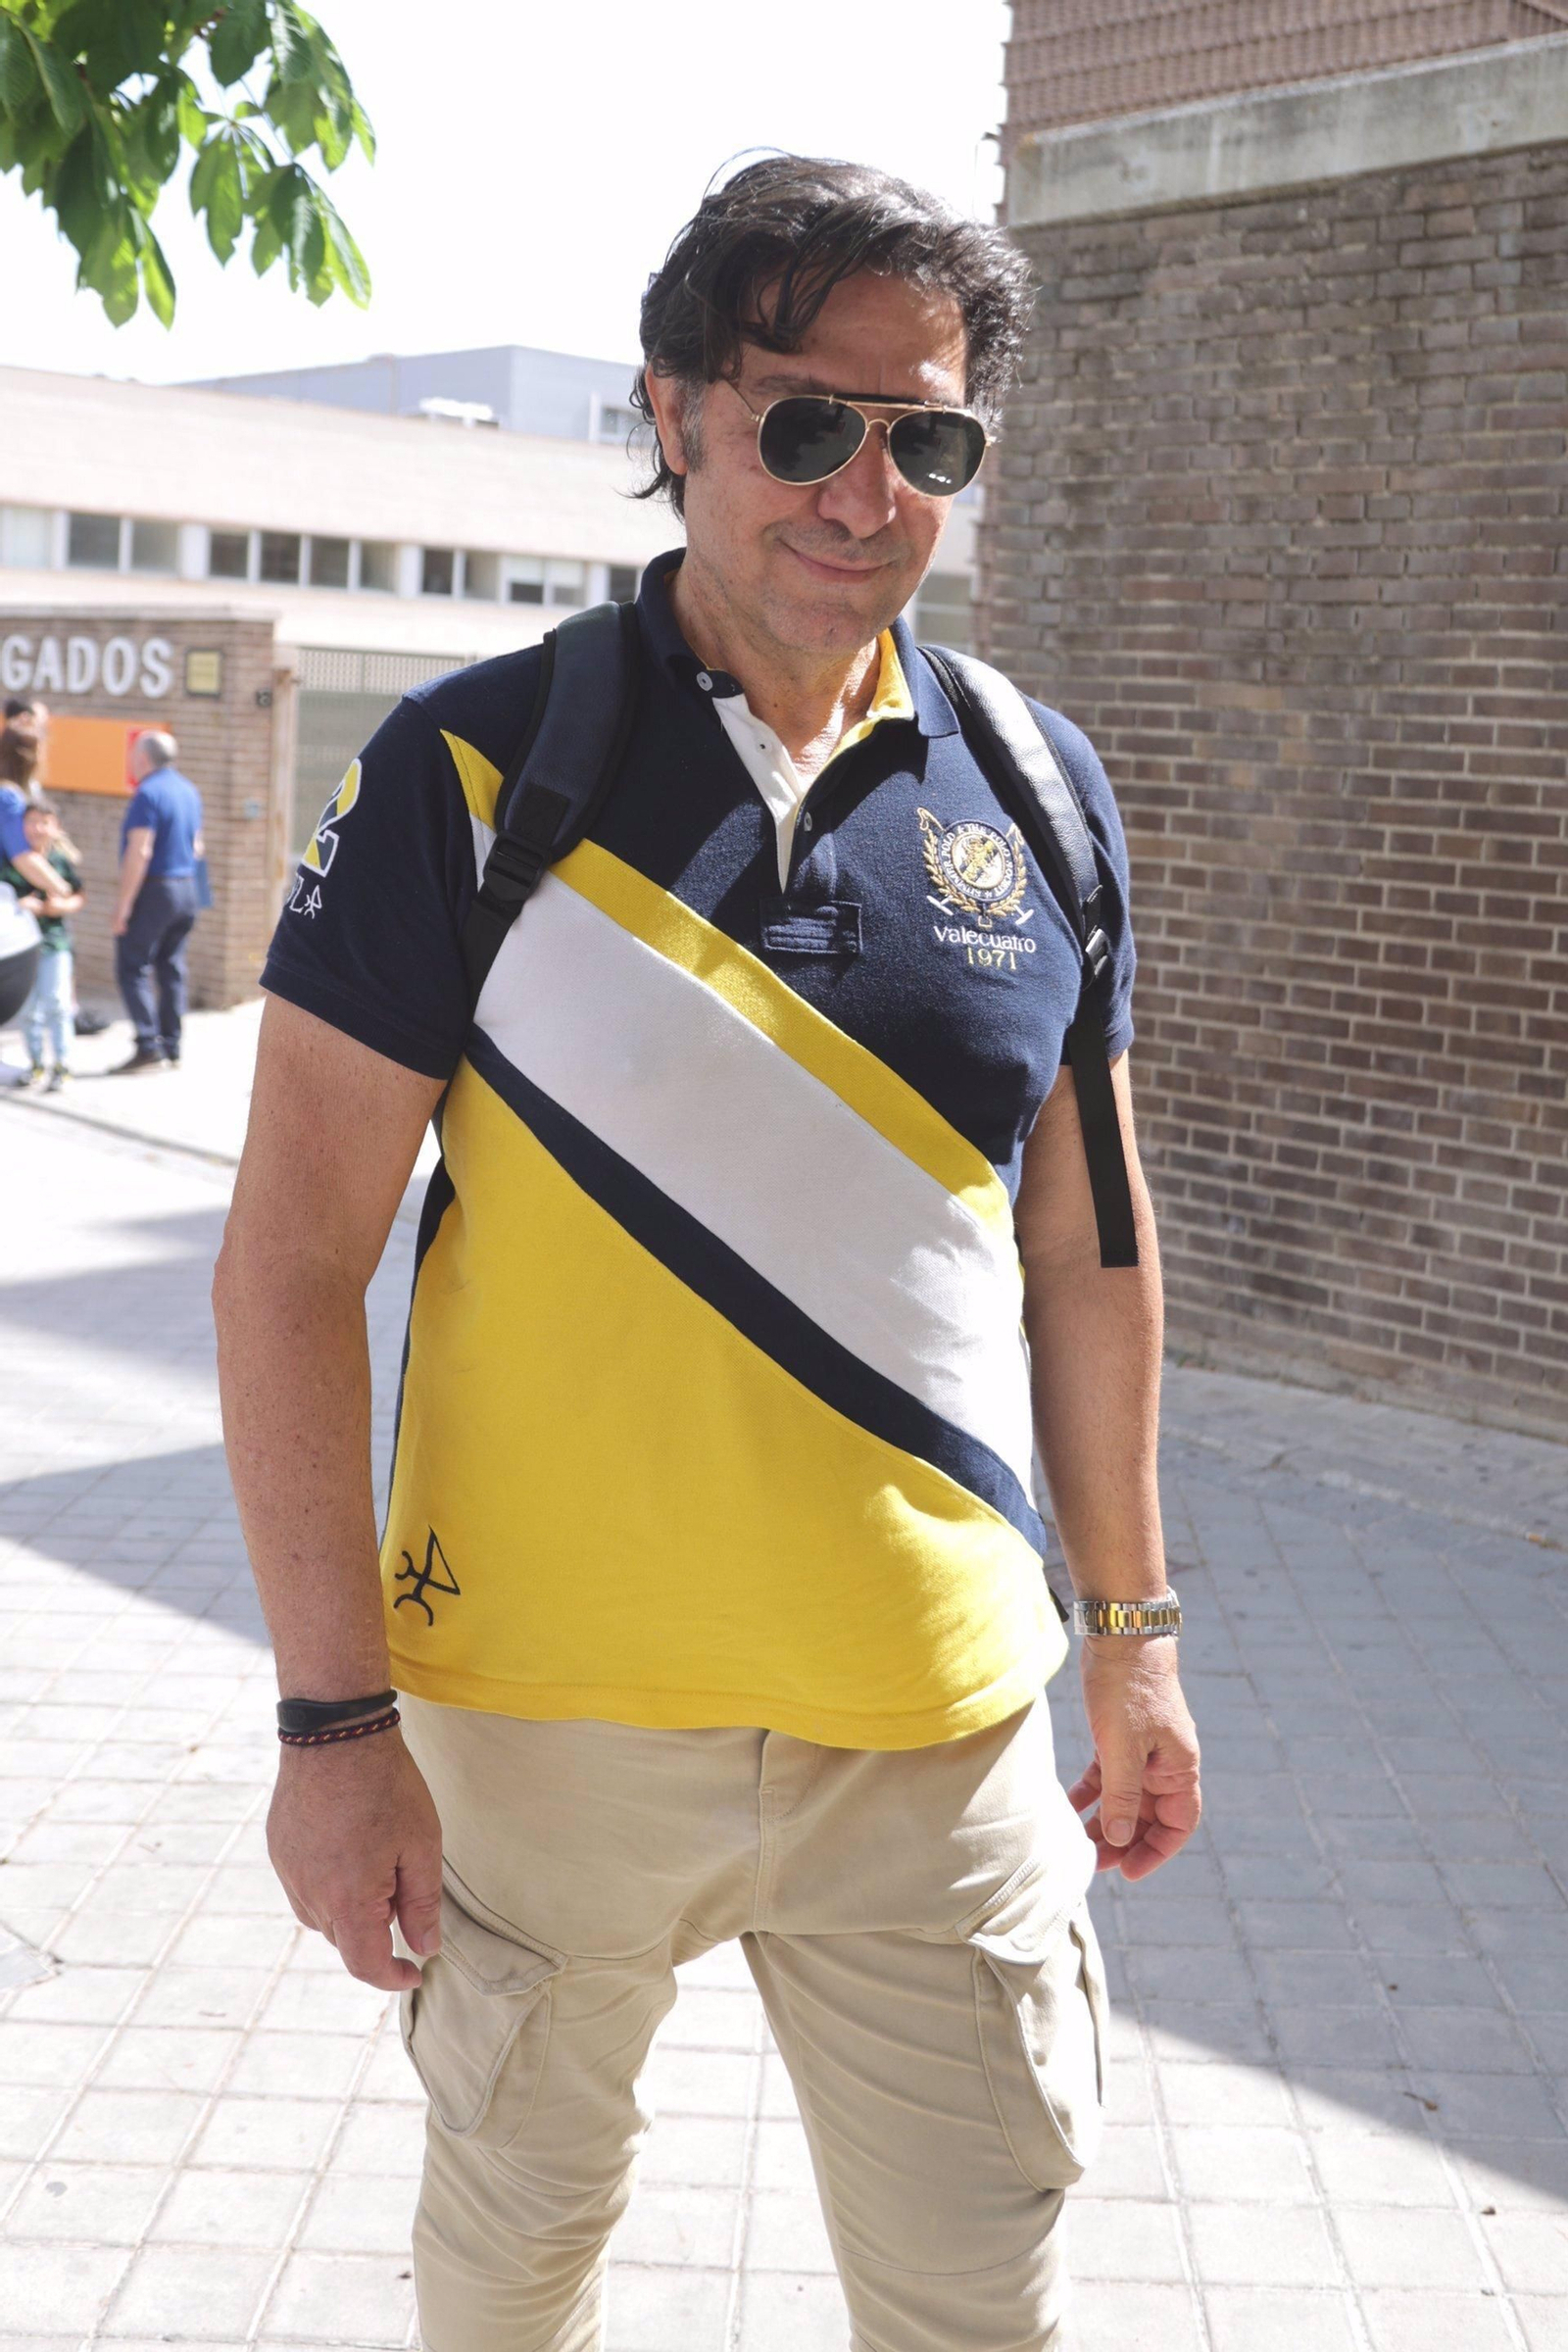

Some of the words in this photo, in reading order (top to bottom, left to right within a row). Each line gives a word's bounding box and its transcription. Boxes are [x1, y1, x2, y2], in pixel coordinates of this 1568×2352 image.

[2, 635, 173, 698] GADOS
[941, 832, 956, 858] POLO
[964, 823, 987, 835] THE
[989, 831, 1010, 857] POLO
[967, 947, 1016, 970] 1971
